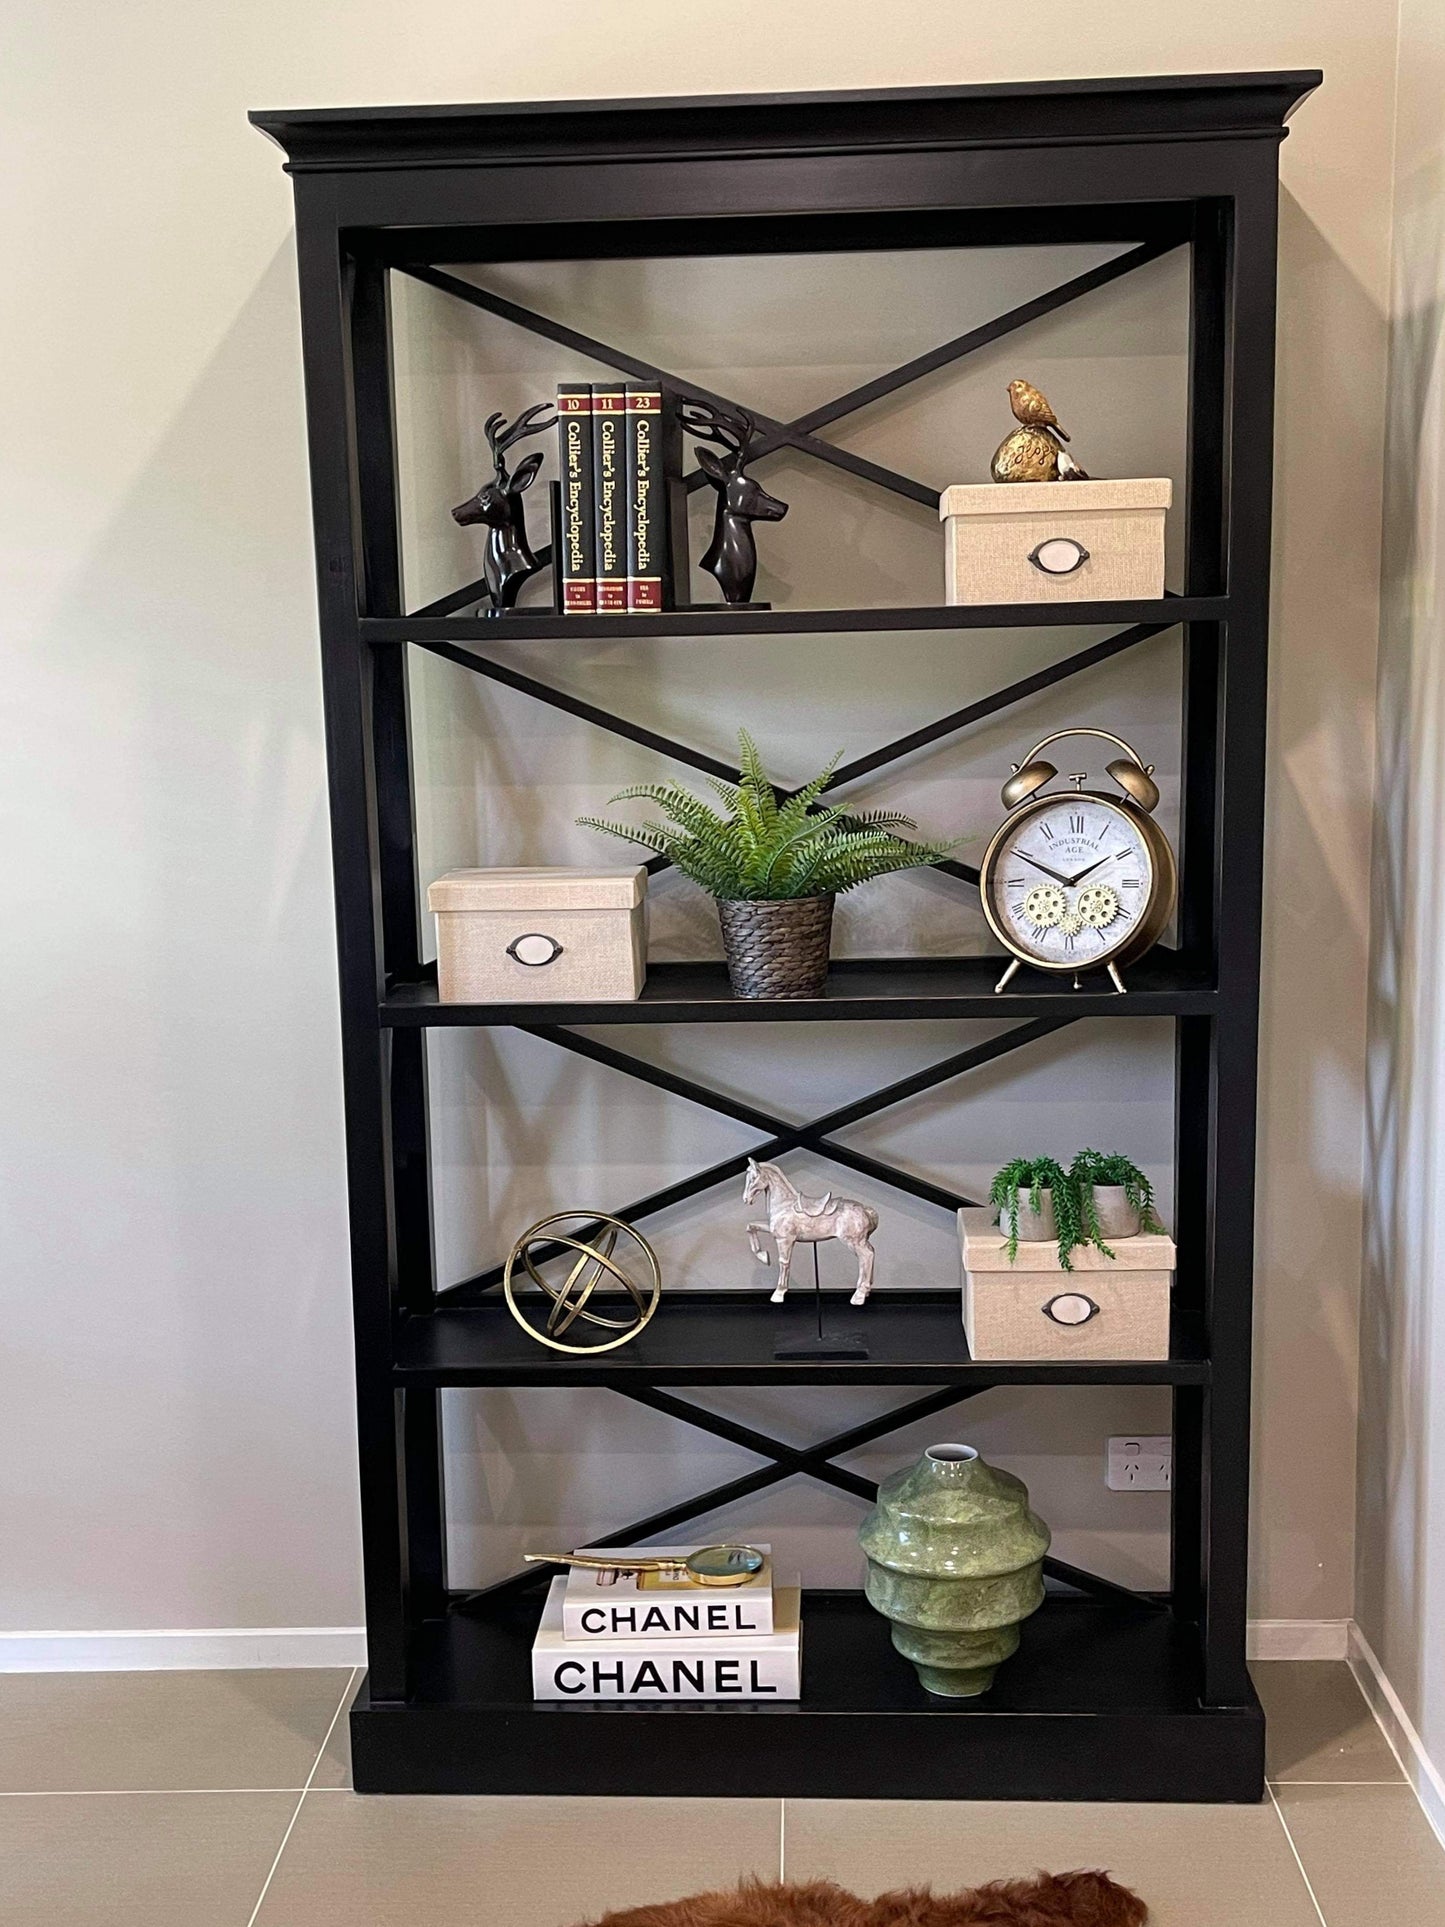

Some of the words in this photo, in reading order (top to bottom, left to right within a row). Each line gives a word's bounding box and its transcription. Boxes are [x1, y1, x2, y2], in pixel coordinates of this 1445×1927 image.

[567, 399, 579, 410] 10
[602, 398, 613, 409] 11
[636, 397, 650, 408] 23
[567, 421, 582, 478] Collier's
[601, 421, 616, 478] Collier's
[636, 420, 650, 477] Collier's
[566, 481, 583, 572] Encyclopedia
[600, 480, 617, 571] Encyclopedia
[635, 480, 651, 570] Encyclopedia
[1048, 837, 1100, 851] INDUSTRIAL
[1065, 846, 1084, 854] AGE
[581, 1604, 757, 1634] CHANEL
[554, 1660, 777, 1694] CHANEL
